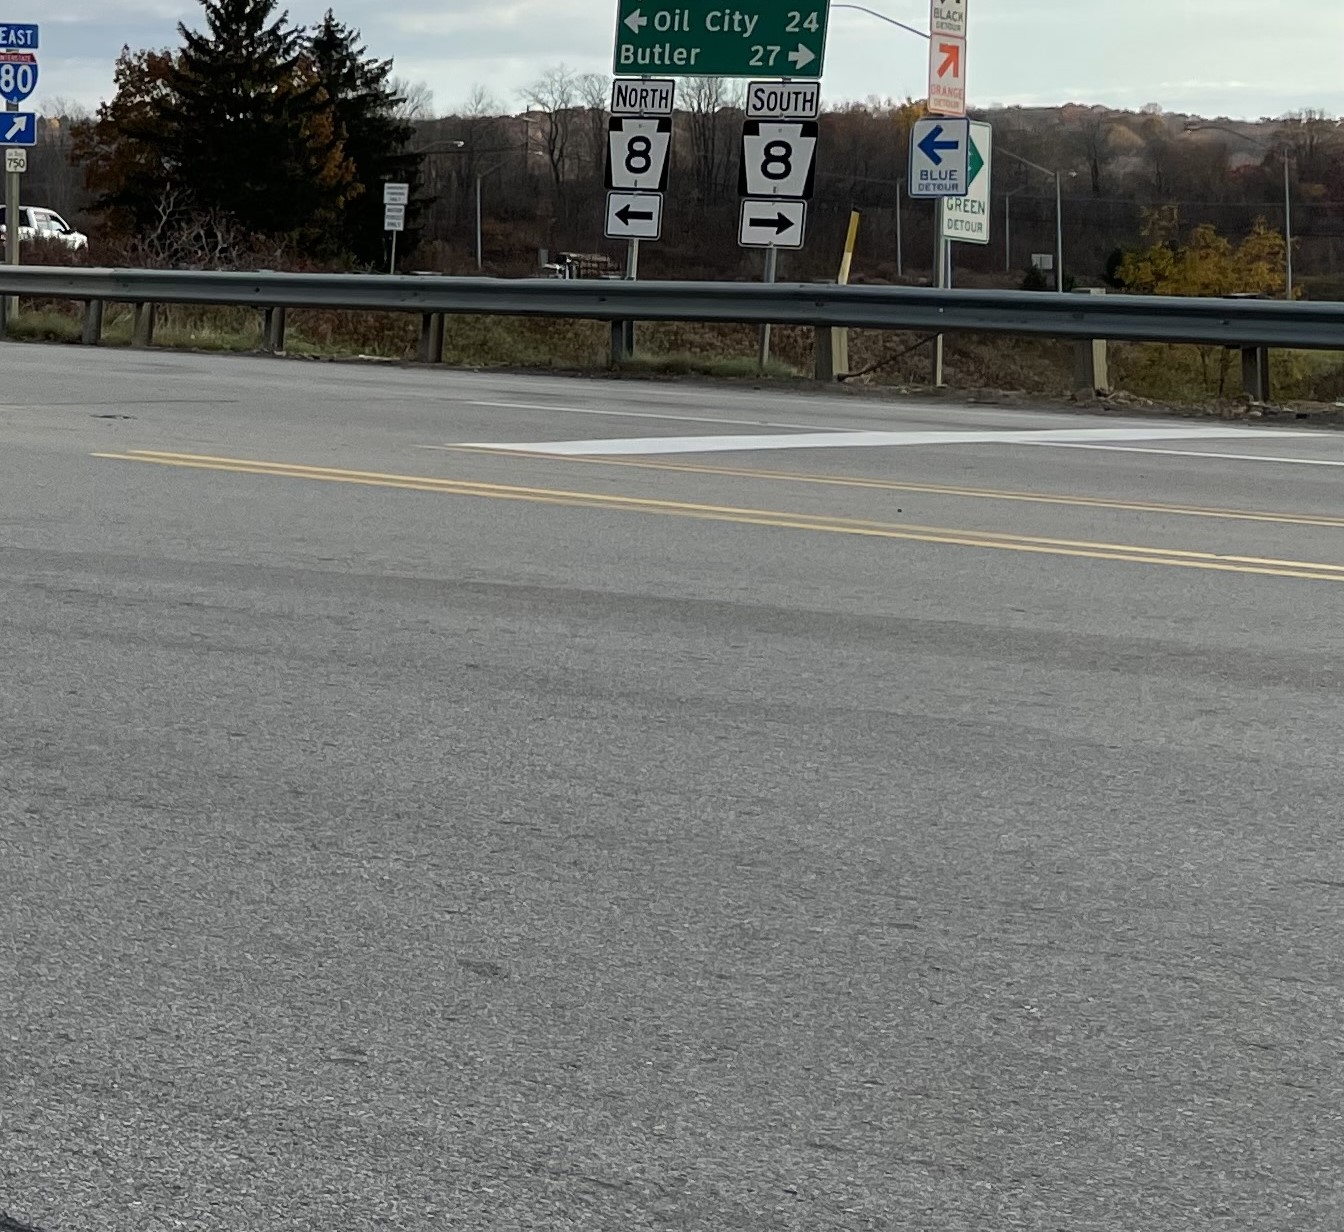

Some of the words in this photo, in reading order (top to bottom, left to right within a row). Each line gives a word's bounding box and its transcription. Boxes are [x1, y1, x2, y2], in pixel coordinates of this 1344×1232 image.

[653, 9, 690, 32] Oil
[705, 10, 759, 38] City
[785, 11, 820, 32] 24
[933, 7, 964, 23] BLACK
[935, 21, 961, 31] DETOUR
[620, 43, 701, 65] Butler
[748, 45, 781, 66] 27
[0, 64, 33, 94] 80
[615, 85, 670, 109] NORTH
[752, 88, 815, 112] SOUTH
[930, 83, 964, 100] ORANGE
[7, 158, 25, 168] 750
[625, 135, 652, 174] 8
[760, 140, 793, 181] 8
[920, 169, 958, 181] BLUE
[918, 183, 959, 192] DETOUR
[946, 197, 985, 215] GREEN
[947, 218, 983, 233] DETOUR
